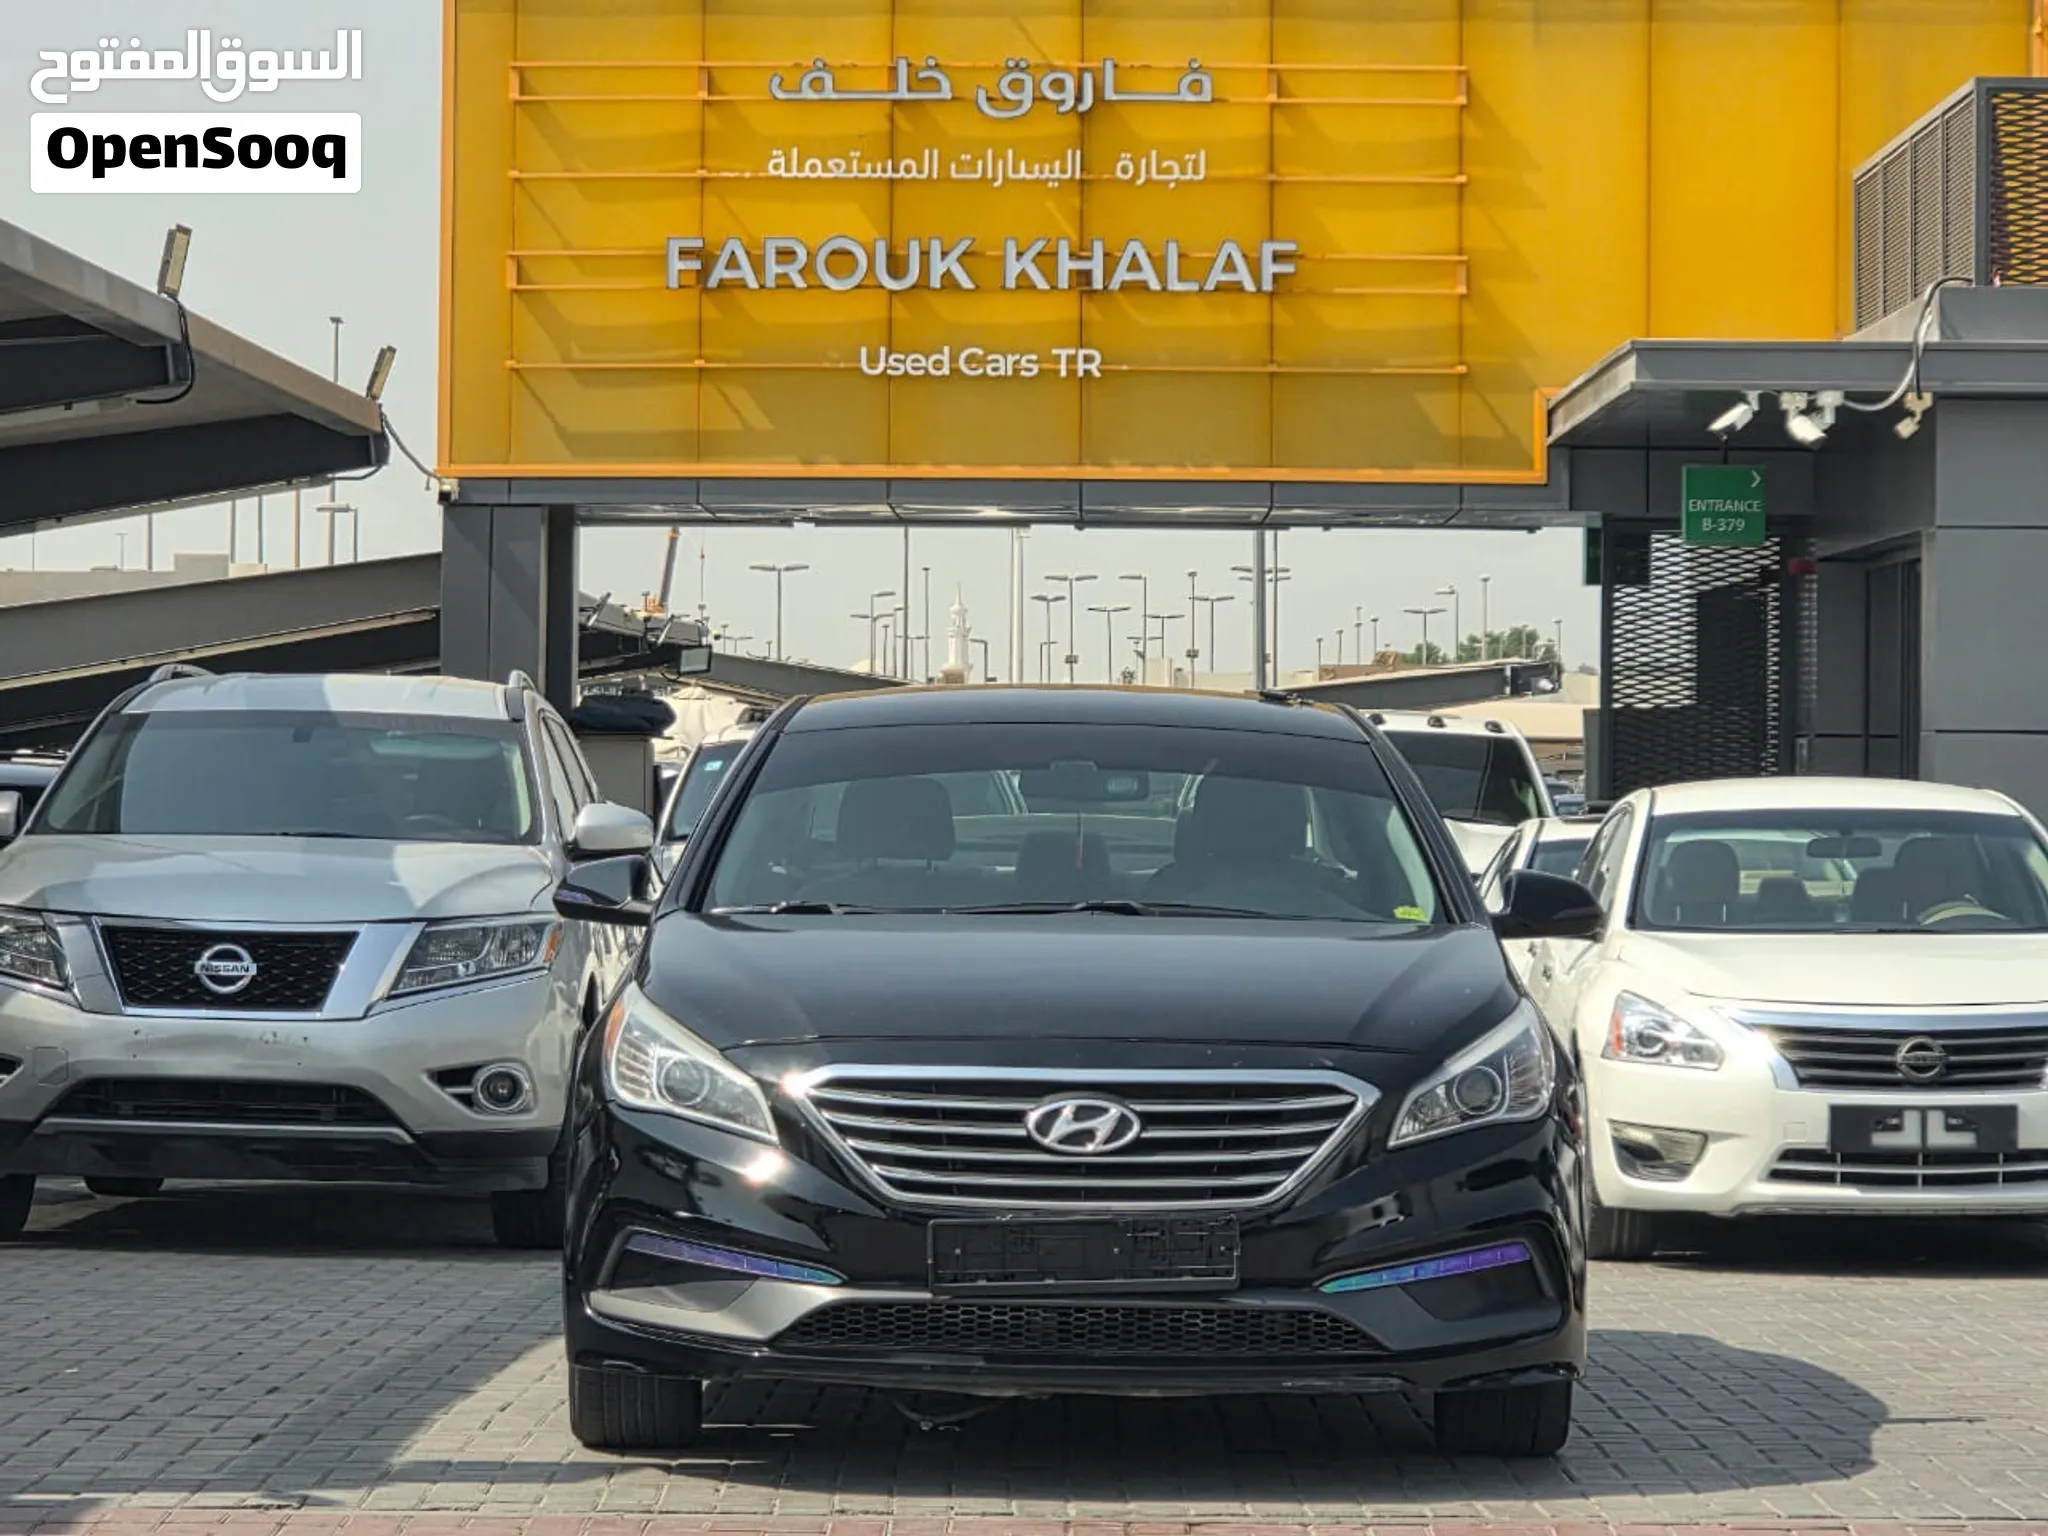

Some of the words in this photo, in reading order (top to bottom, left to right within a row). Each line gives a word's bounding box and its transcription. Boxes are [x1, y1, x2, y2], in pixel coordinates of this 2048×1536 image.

[768, 55, 953, 101] خلف
[976, 57, 1213, 119] فاروق
[767, 147, 940, 180] المستعملة
[1114, 150, 1206, 189] لتجارة
[665, 236, 976, 291] FAROUK
[1004, 237, 1298, 292] KHALAF
[859, 345, 951, 377] Used
[957, 346, 1040, 378] Cars
[1051, 348, 1102, 379] TR
[1687, 498, 1762, 512] ENTRANCE
[1702, 517, 1746, 532] B-379
[200, 962, 250, 974] NISSAN
